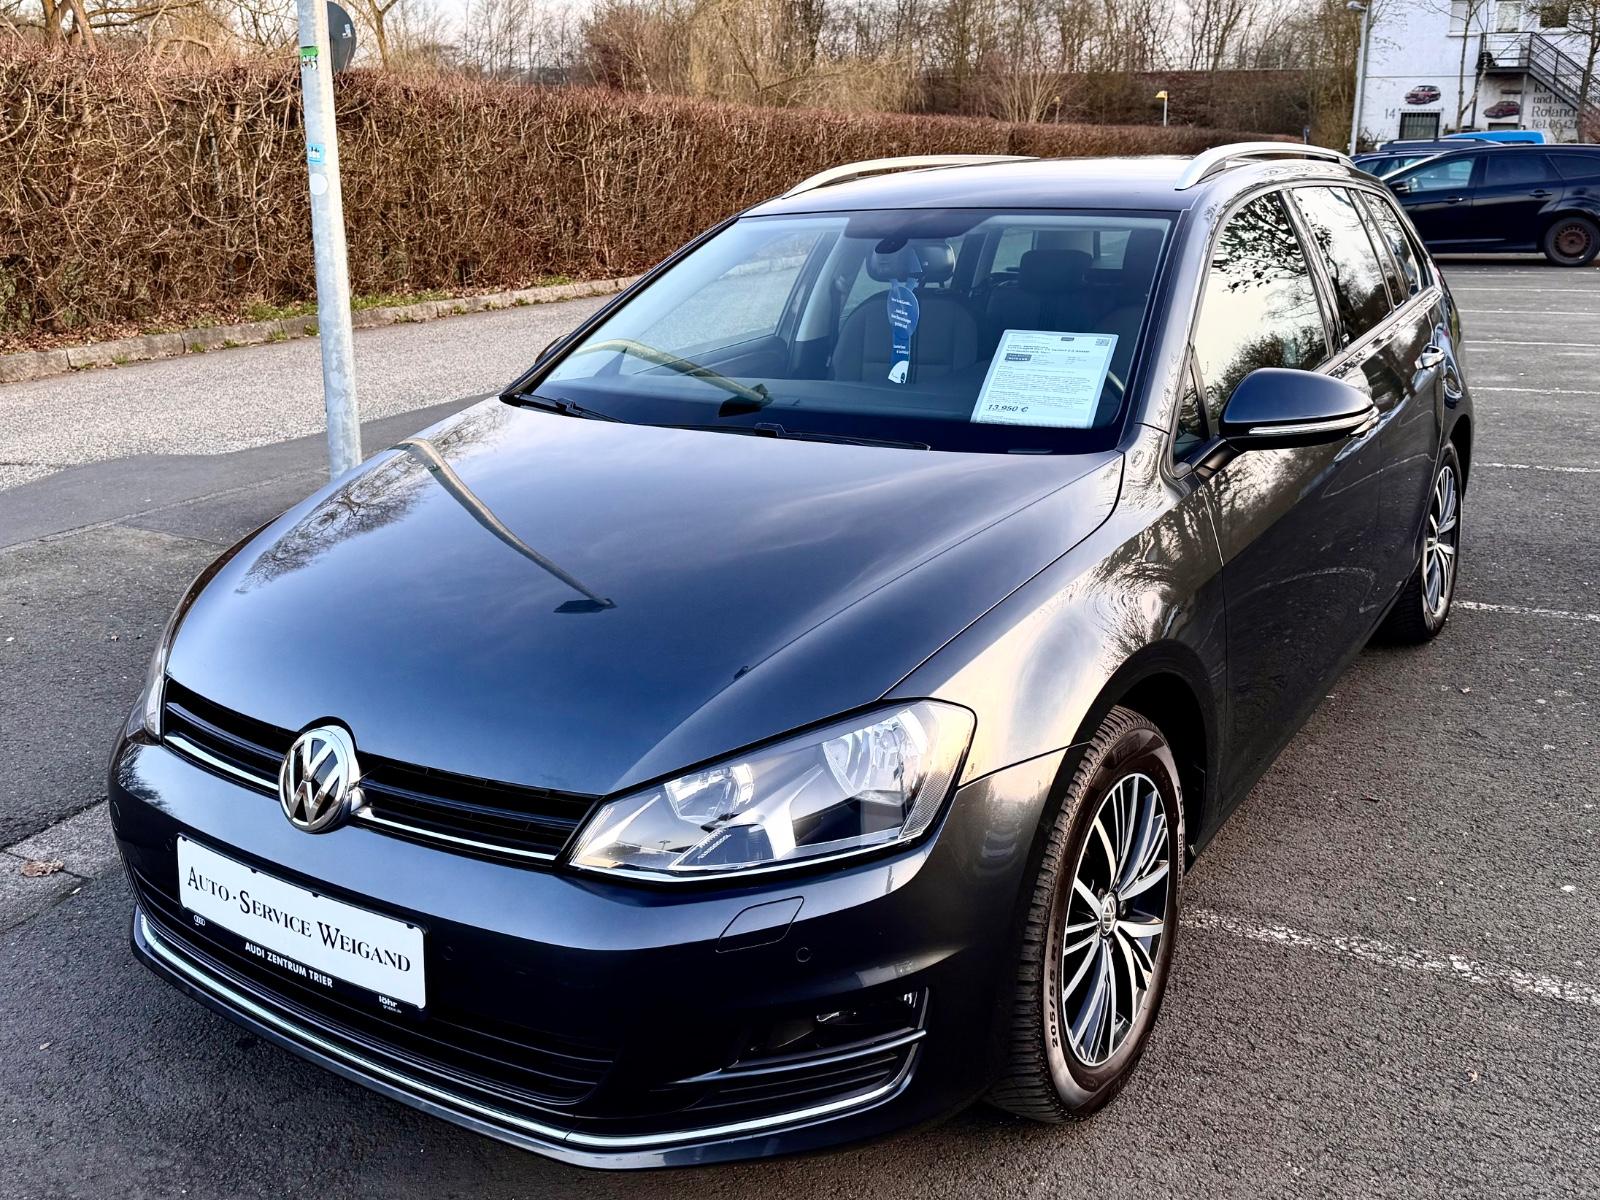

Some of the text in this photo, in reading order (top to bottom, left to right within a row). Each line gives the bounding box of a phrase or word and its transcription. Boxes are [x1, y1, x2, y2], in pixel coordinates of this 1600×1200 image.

[244, 942, 334, 988] AUDI ZENTRUM TRIER
[316, 920, 411, 972] WEIGAND
[1049, 968, 1059, 1049] 205/55
